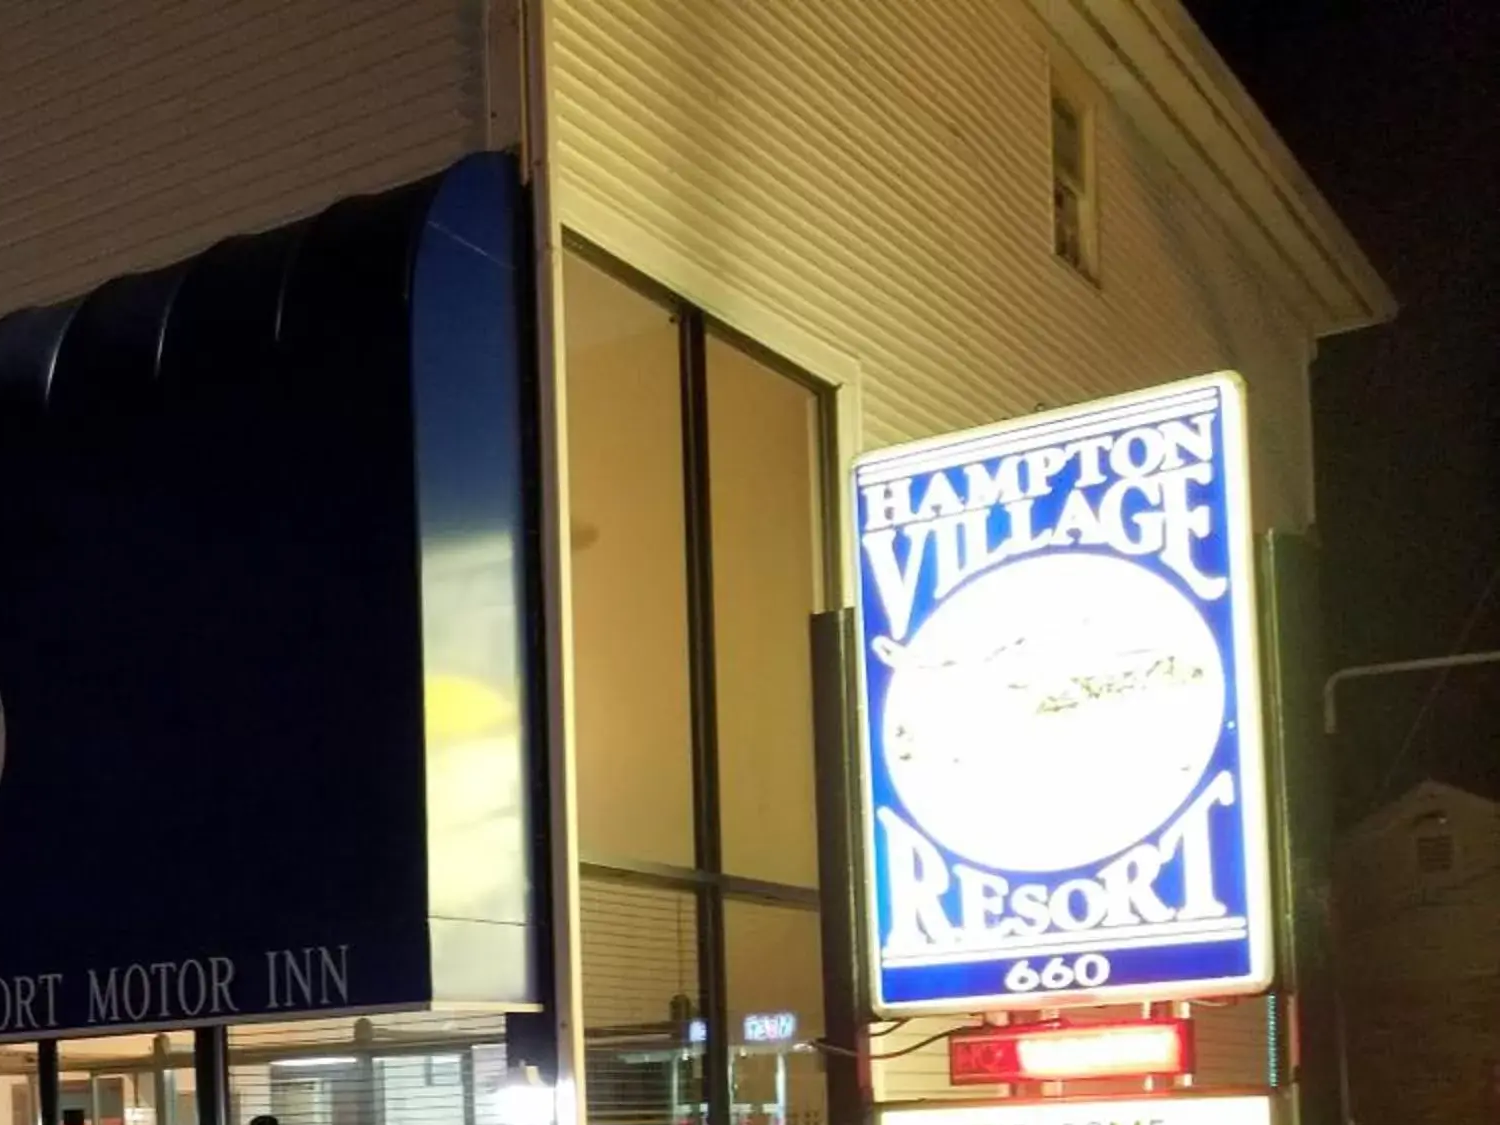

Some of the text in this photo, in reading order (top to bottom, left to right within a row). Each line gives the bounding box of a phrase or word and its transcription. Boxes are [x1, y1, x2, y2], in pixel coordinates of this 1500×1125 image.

[861, 412, 1216, 531] HAMPTON
[862, 461, 1228, 642] VILLAGE
[876, 769, 1235, 957] RESORT
[86, 956, 241, 1025] MOTOR
[264, 943, 351, 1010] INN
[1003, 953, 1111, 993] 660
